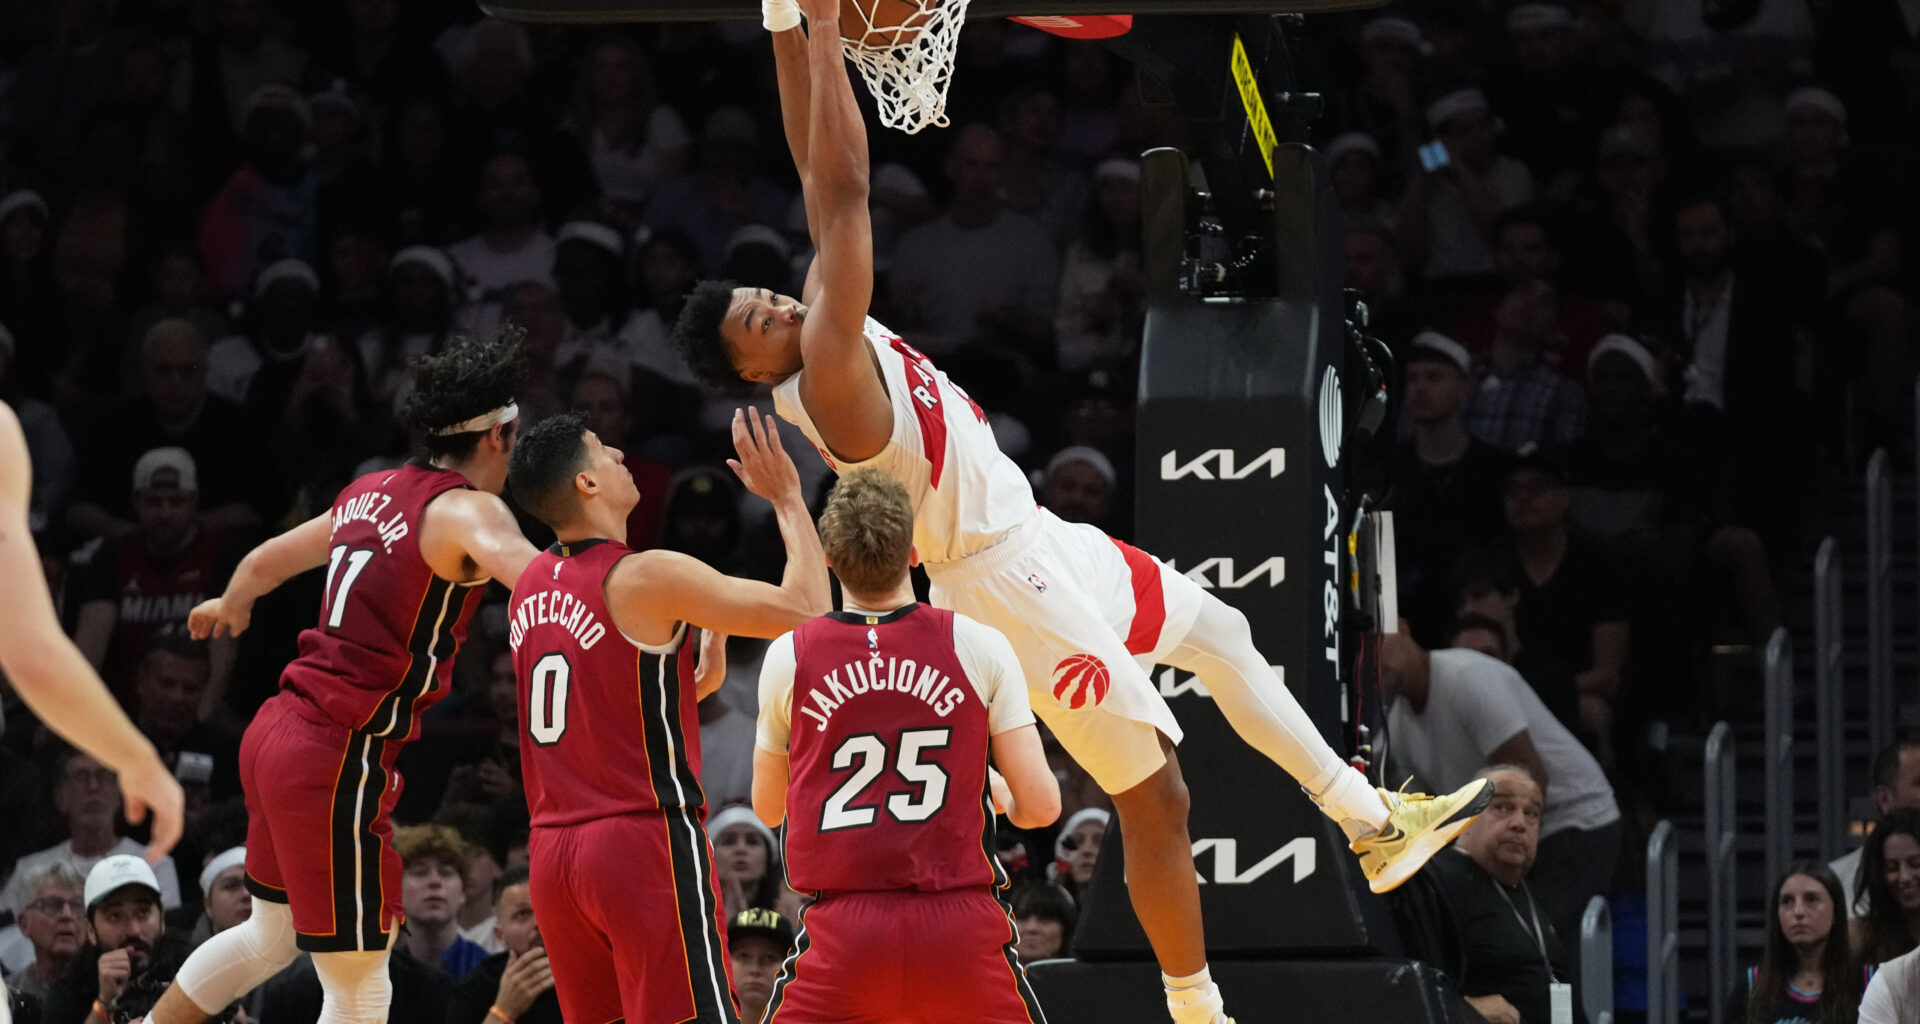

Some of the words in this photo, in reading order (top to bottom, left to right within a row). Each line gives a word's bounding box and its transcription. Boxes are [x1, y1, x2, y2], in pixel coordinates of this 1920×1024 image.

[1161, 448, 1285, 480] KIA
[377, 511, 408, 555] JR.
[326, 543, 376, 629] 11
[1324, 483, 1339, 681] AT&T
[528, 651, 572, 747] 0
[800, 651, 965, 732] JAKUČIONIS
[817, 726, 953, 834] 25
